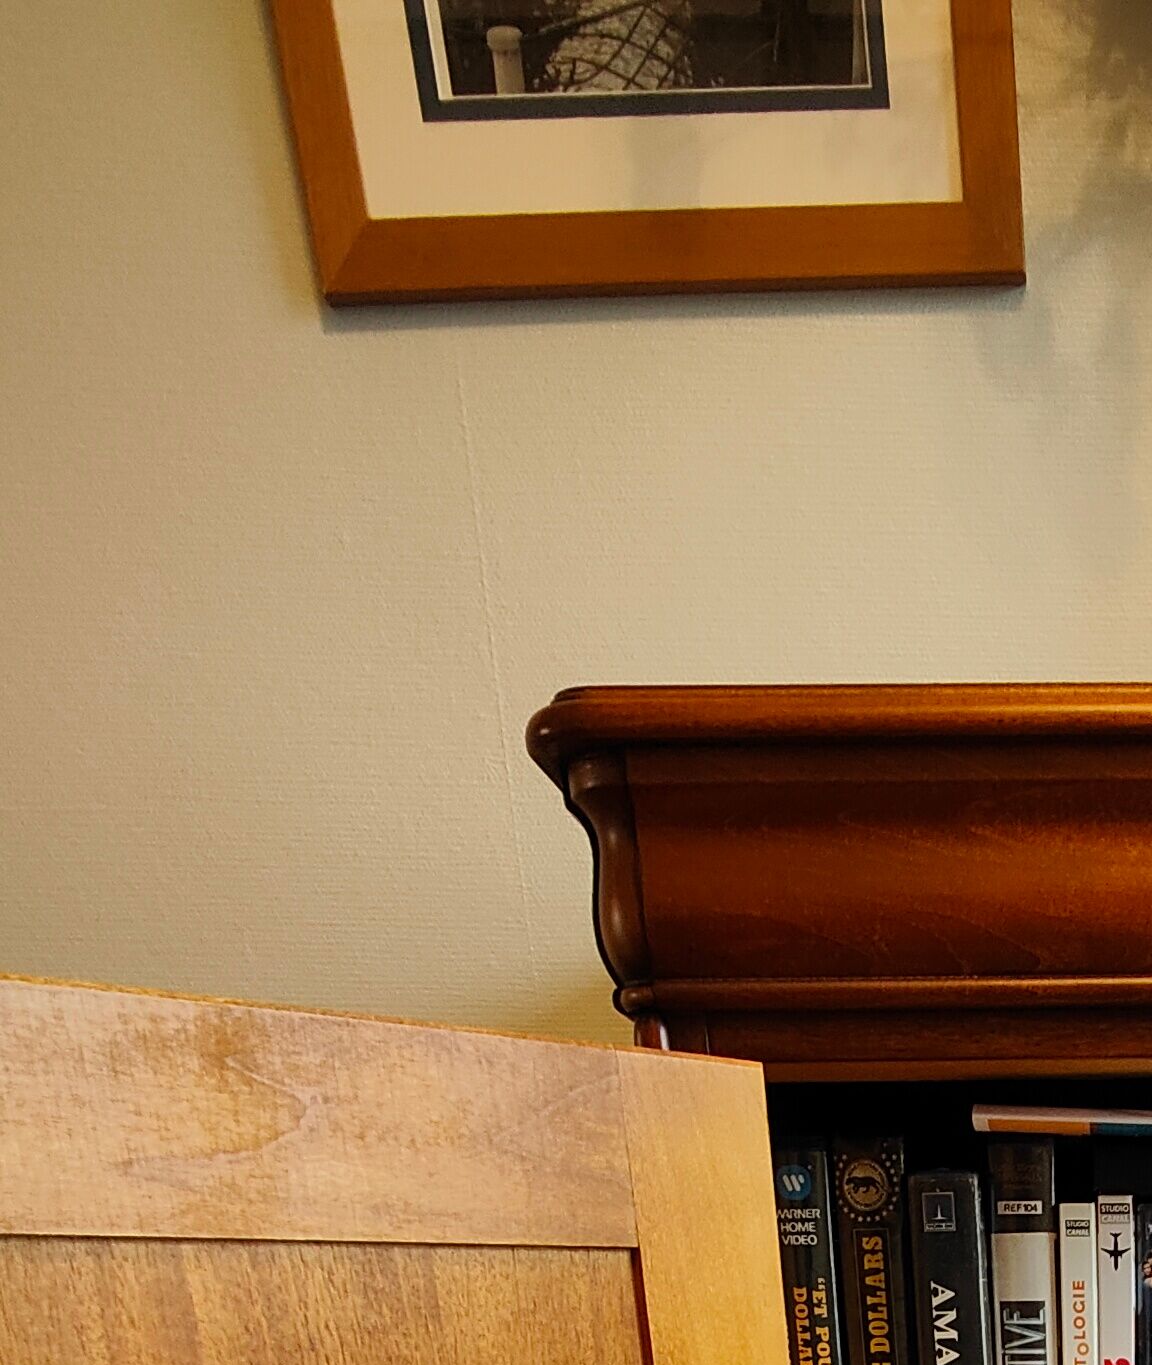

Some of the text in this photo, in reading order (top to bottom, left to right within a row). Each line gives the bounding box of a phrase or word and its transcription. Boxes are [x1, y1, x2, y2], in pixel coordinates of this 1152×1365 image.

[1003, 1203, 1022, 1213] REF
[1101, 1204, 1130, 1213] STUDIO
[1101, 1213, 1130, 1223] CANAL
[780, 1221, 817, 1232] HOME
[1066, 1219, 1090, 1228] STUDIO
[1066, 1228, 1091, 1236] CANAL
[781, 1234, 818, 1246] VIDEO
[862, 1235, 891, 1354] DOLLARS
